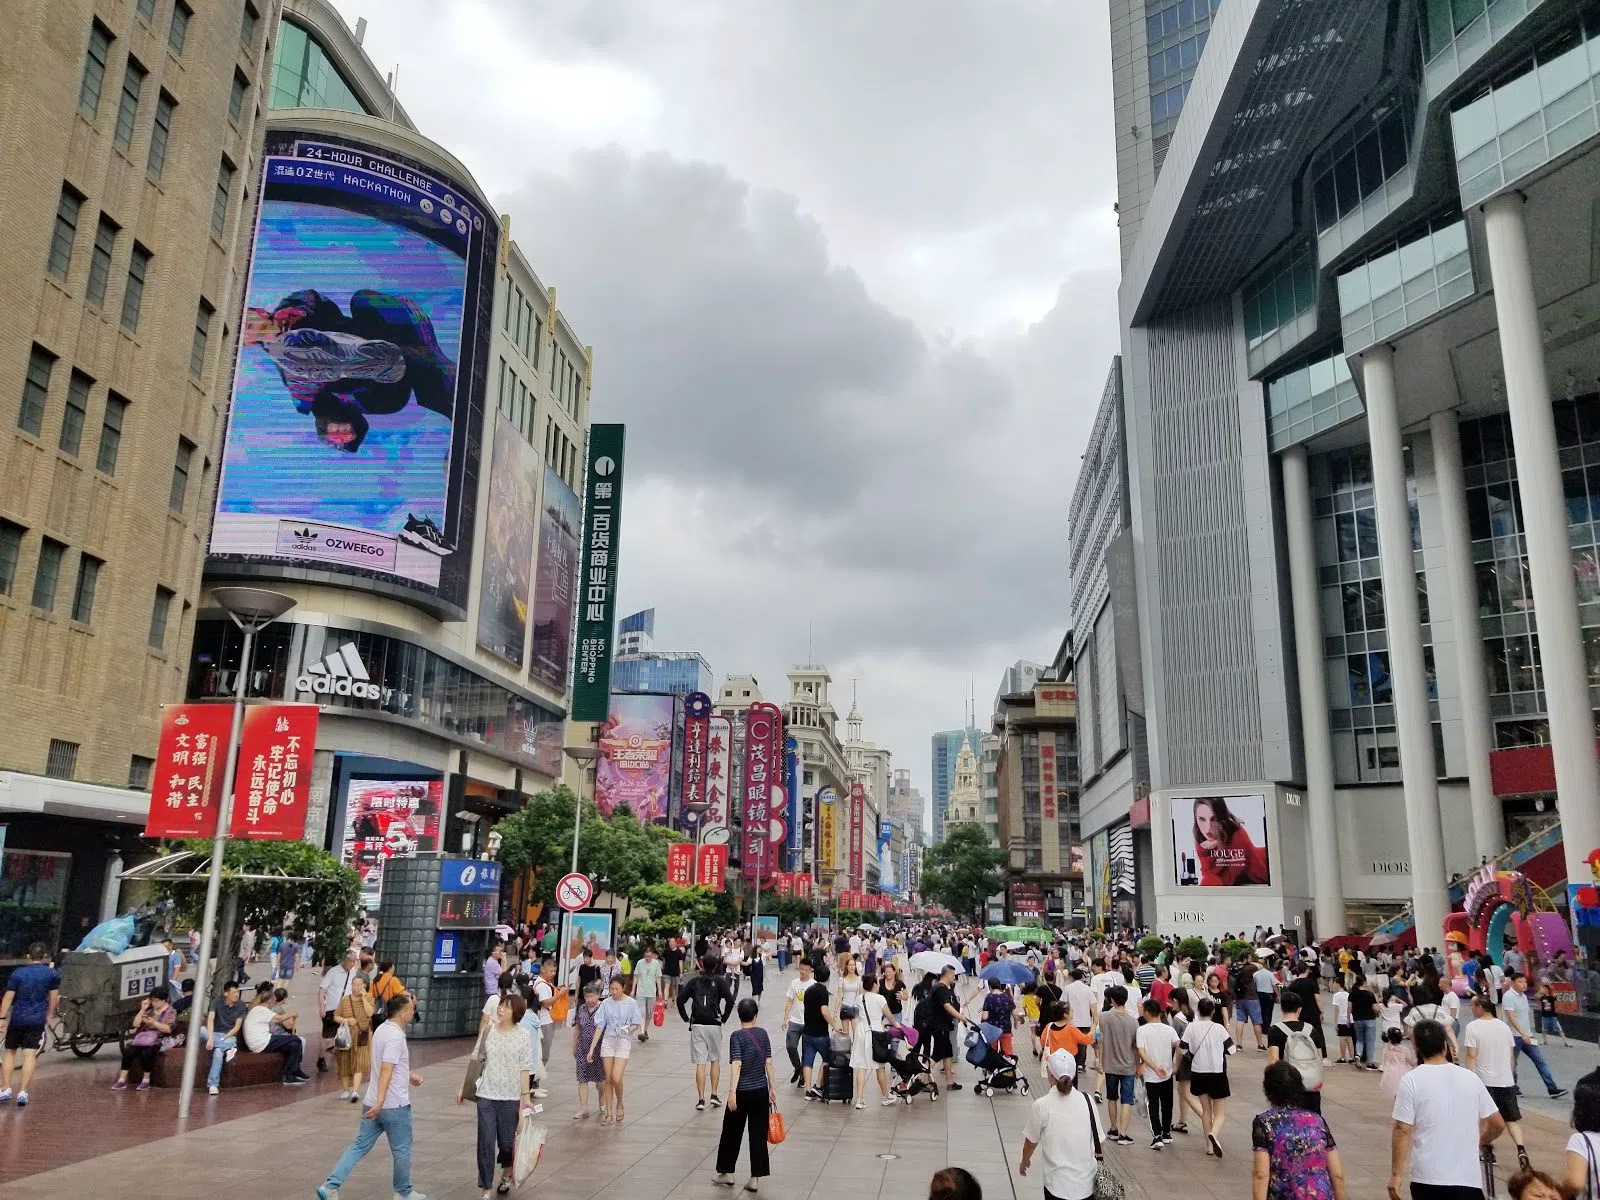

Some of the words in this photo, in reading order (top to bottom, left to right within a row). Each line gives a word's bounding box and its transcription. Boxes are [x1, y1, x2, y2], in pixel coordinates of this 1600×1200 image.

[306, 147, 363, 168] 24-HOUR
[369, 160, 433, 192] CHALLENGE
[343, 174, 412, 204] HACKATHON
[292, 543, 317, 552] adidas
[325, 538, 385, 557] OZWEEGO
[586, 482, 612, 622] 第一百货商业中心
[581, 638, 590, 674] CENTER
[588, 639, 598, 684] SHOPPING
[597, 639, 605, 658] NO.1
[295, 674, 381, 700] adidas
[172, 733, 190, 766] 文明
[191, 733, 211, 765] 富强
[263, 745, 285, 816] 牢记使命
[279, 735, 301, 806] 不忘初心
[166, 774, 186, 809] 和谐
[186, 775, 203, 808] 民主
[246, 755, 267, 825] 永远奋斗
[370, 796, 420, 809] 限时特惠
[1210, 848, 1245, 858] ROUGE
[1372, 862, 1409, 873] DIOR
[1174, 911, 1206, 923] DIOR
